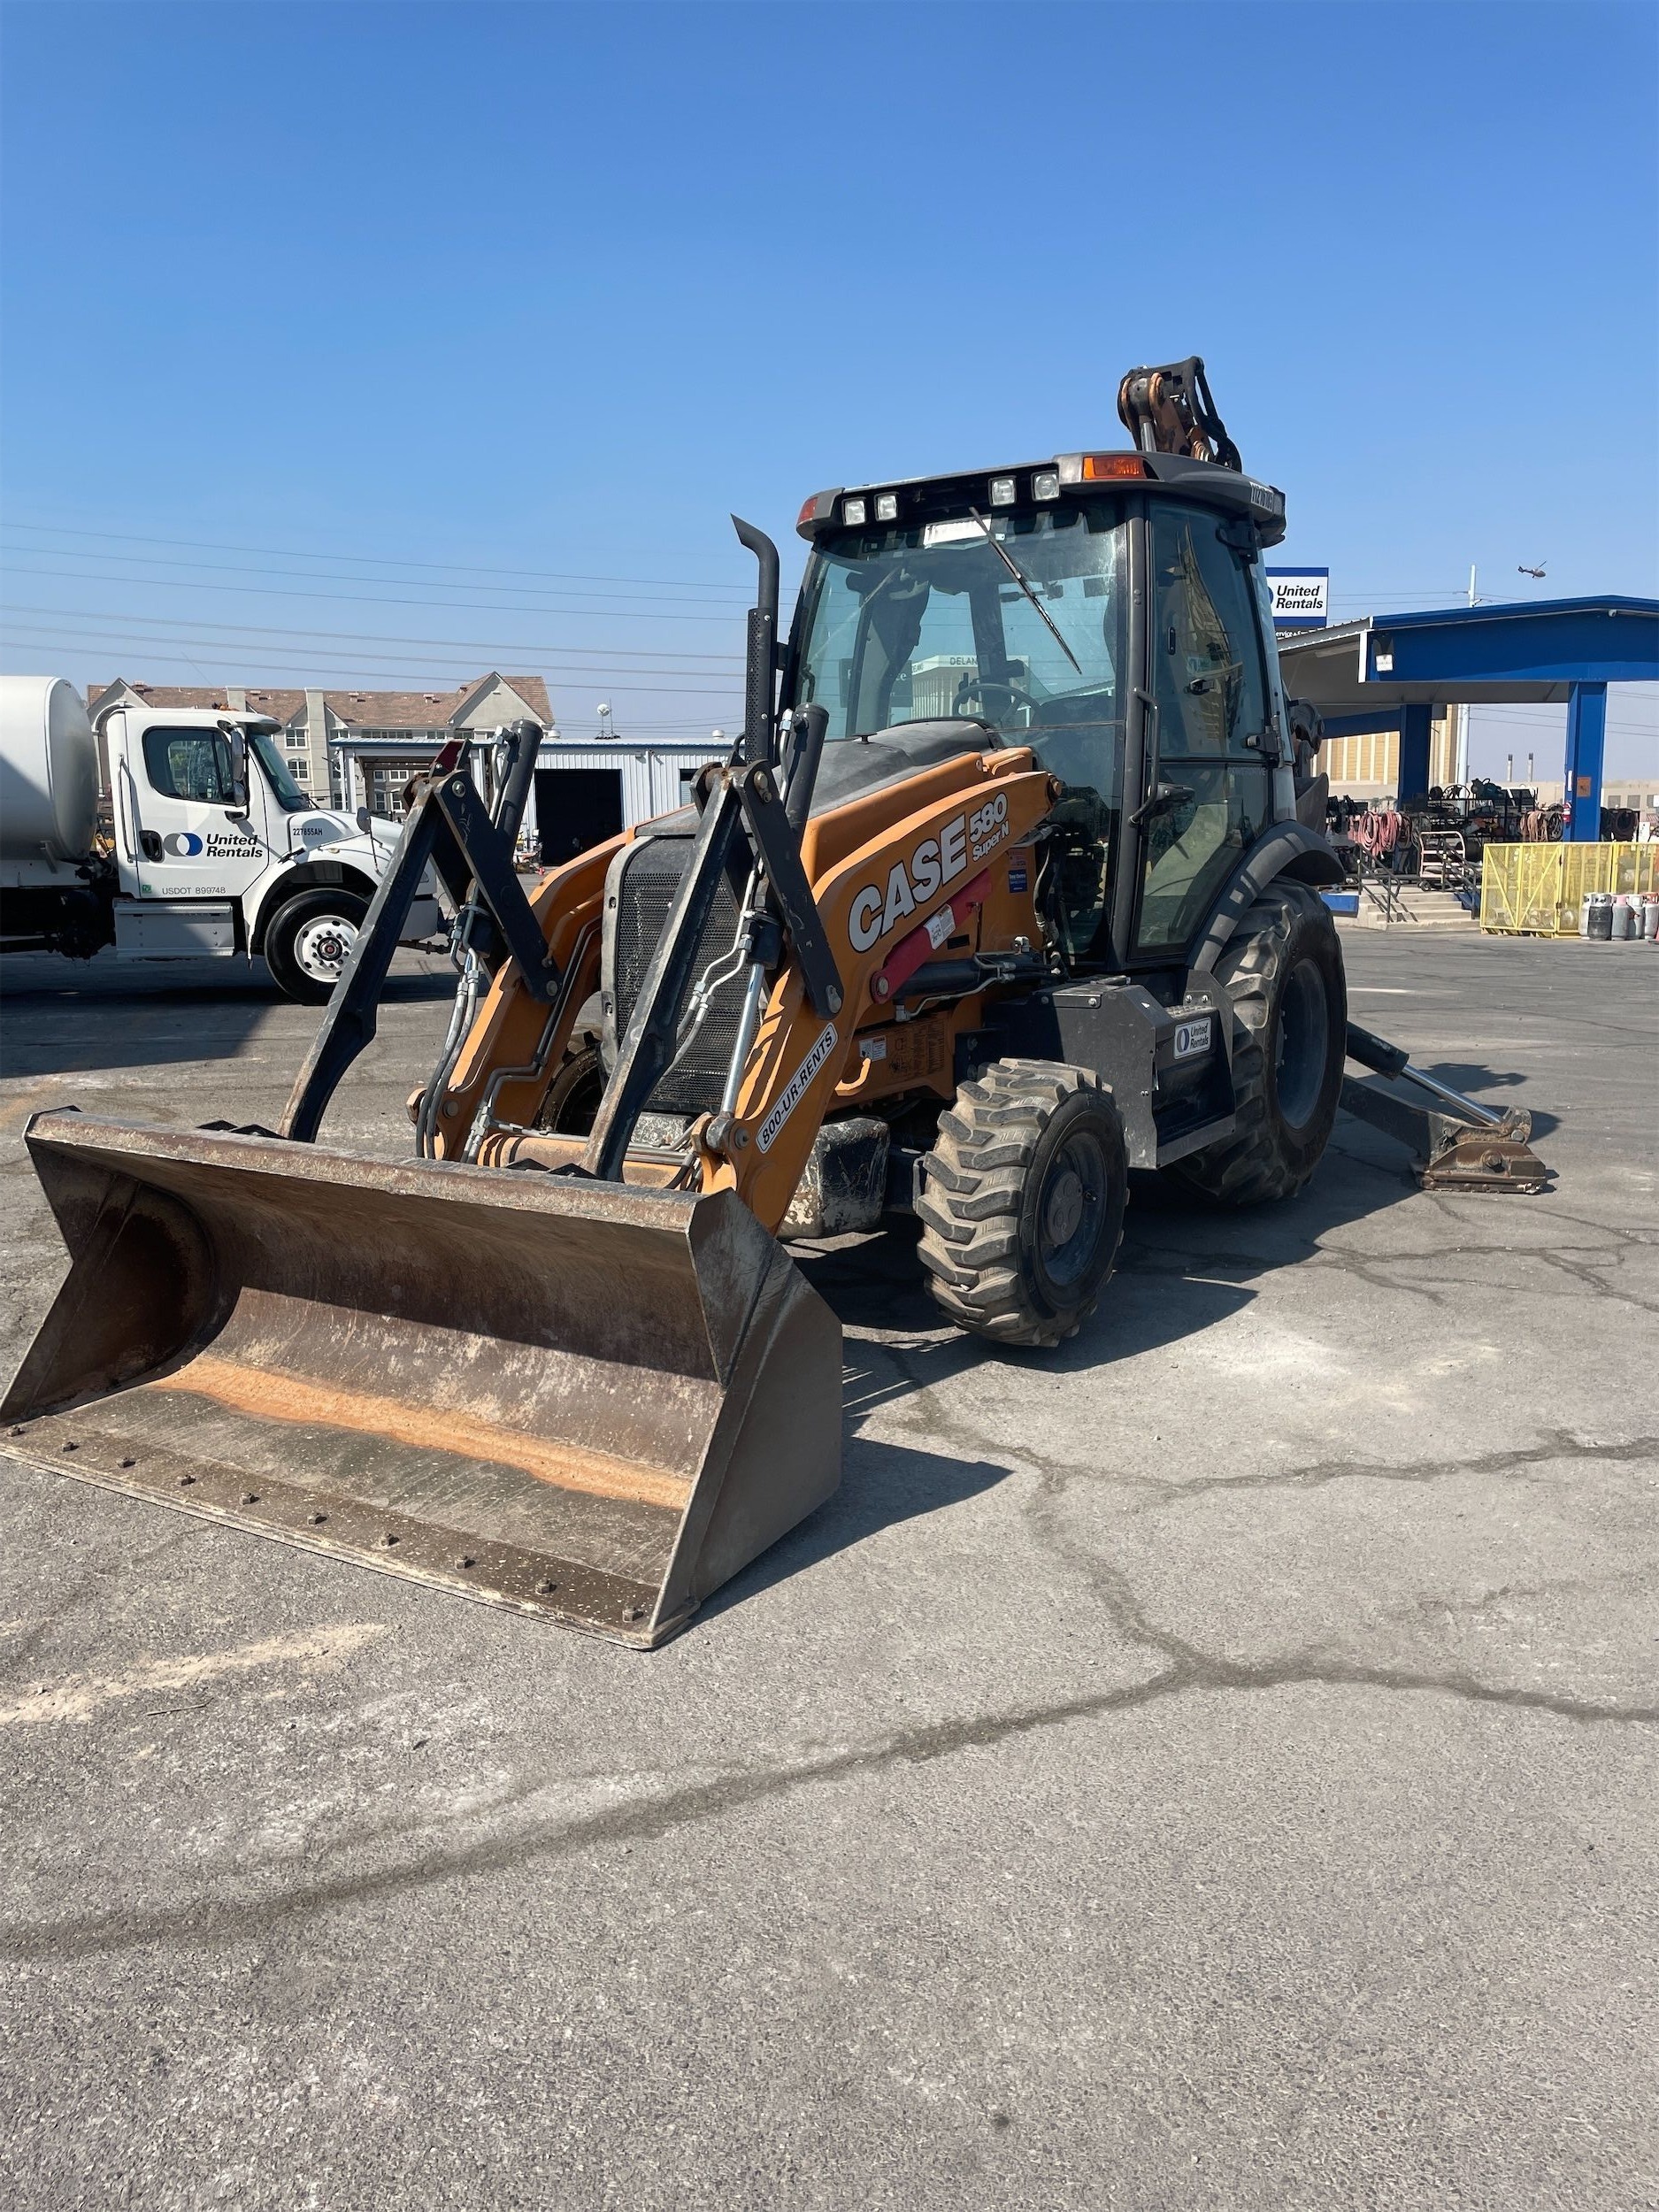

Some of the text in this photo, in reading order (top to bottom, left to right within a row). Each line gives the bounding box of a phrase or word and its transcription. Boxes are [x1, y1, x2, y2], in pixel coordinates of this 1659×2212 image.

[1277, 585, 1320, 596] United
[1276, 597, 1324, 609] Rentals
[949, 657, 979, 665] DELAN
[969, 792, 1008, 843] 580
[206, 833, 259, 846] United
[972, 828, 1002, 862] Super
[1001, 818, 1010, 840] N
[206, 847, 264, 858] Rentals
[848, 811, 968, 954] CASE
[1190, 1022, 1209, 1037] United
[1190, 1034, 1210, 1048] Rentals
[761, 1031, 833, 1145] 800-UR-RENTS
